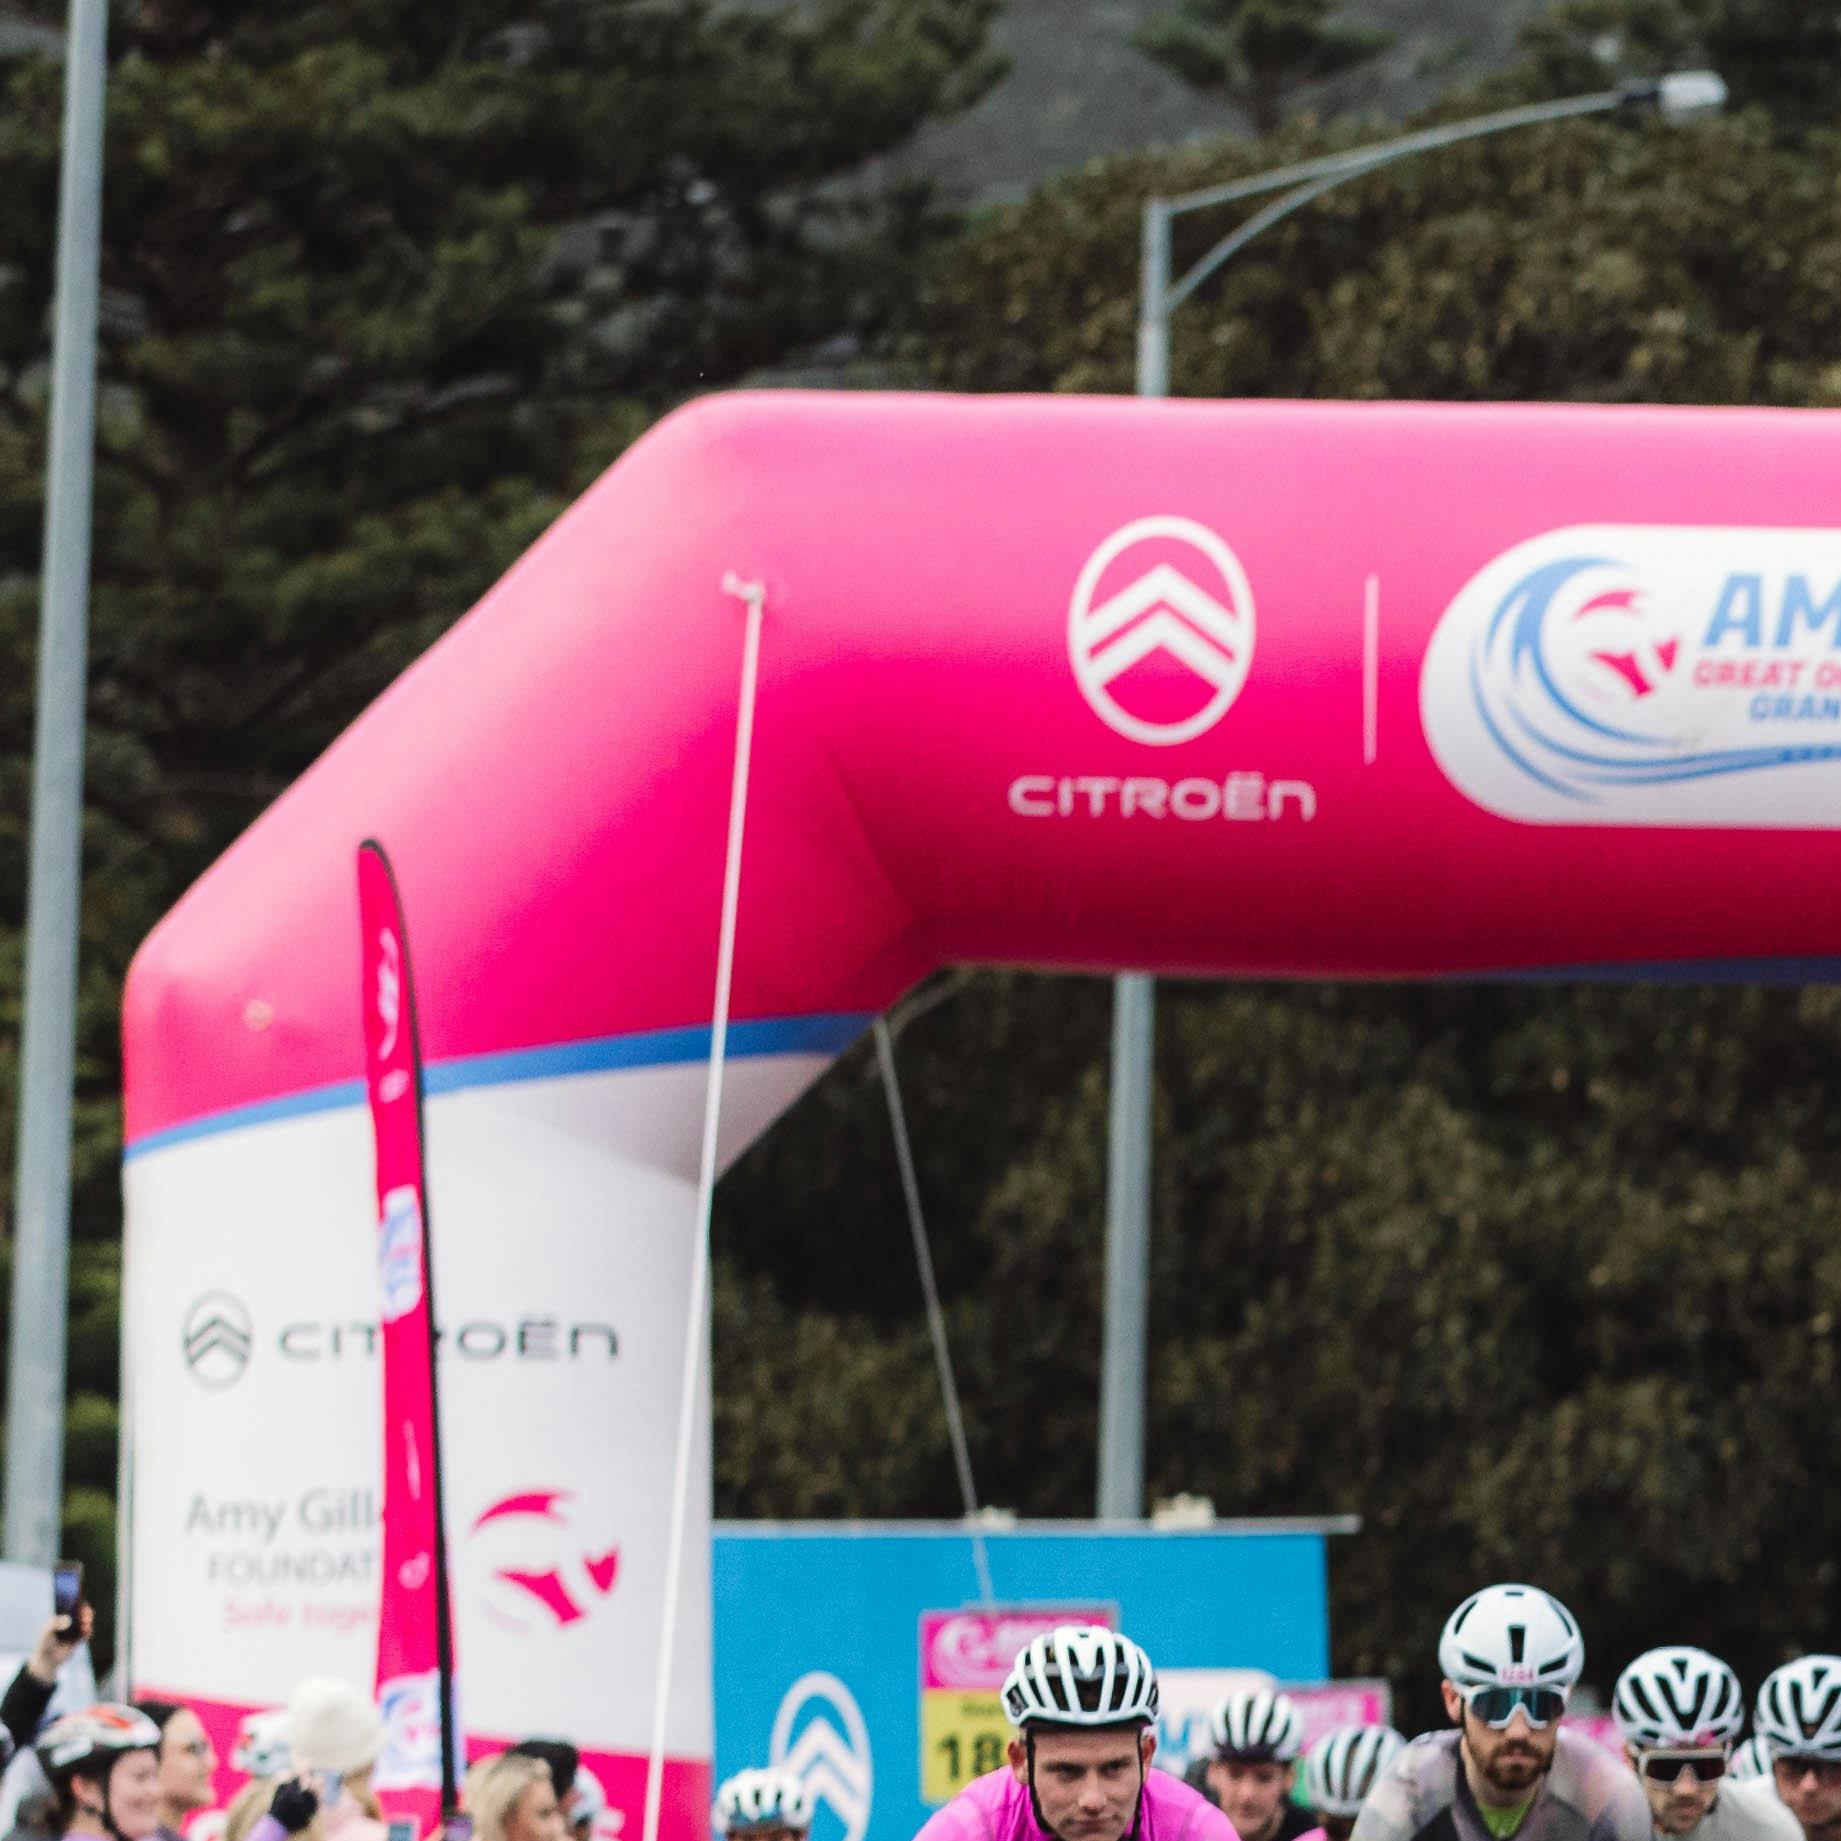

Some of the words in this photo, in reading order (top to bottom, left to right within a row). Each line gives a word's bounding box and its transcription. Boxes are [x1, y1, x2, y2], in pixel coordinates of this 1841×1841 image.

[1692, 658, 1807, 690] GREAT
[1749, 694, 1841, 723] GRAN
[278, 1314, 619, 1361] CITOËN
[299, 1488, 383, 1534] Gill
[208, 1551, 375, 1585] FOUNDAT
